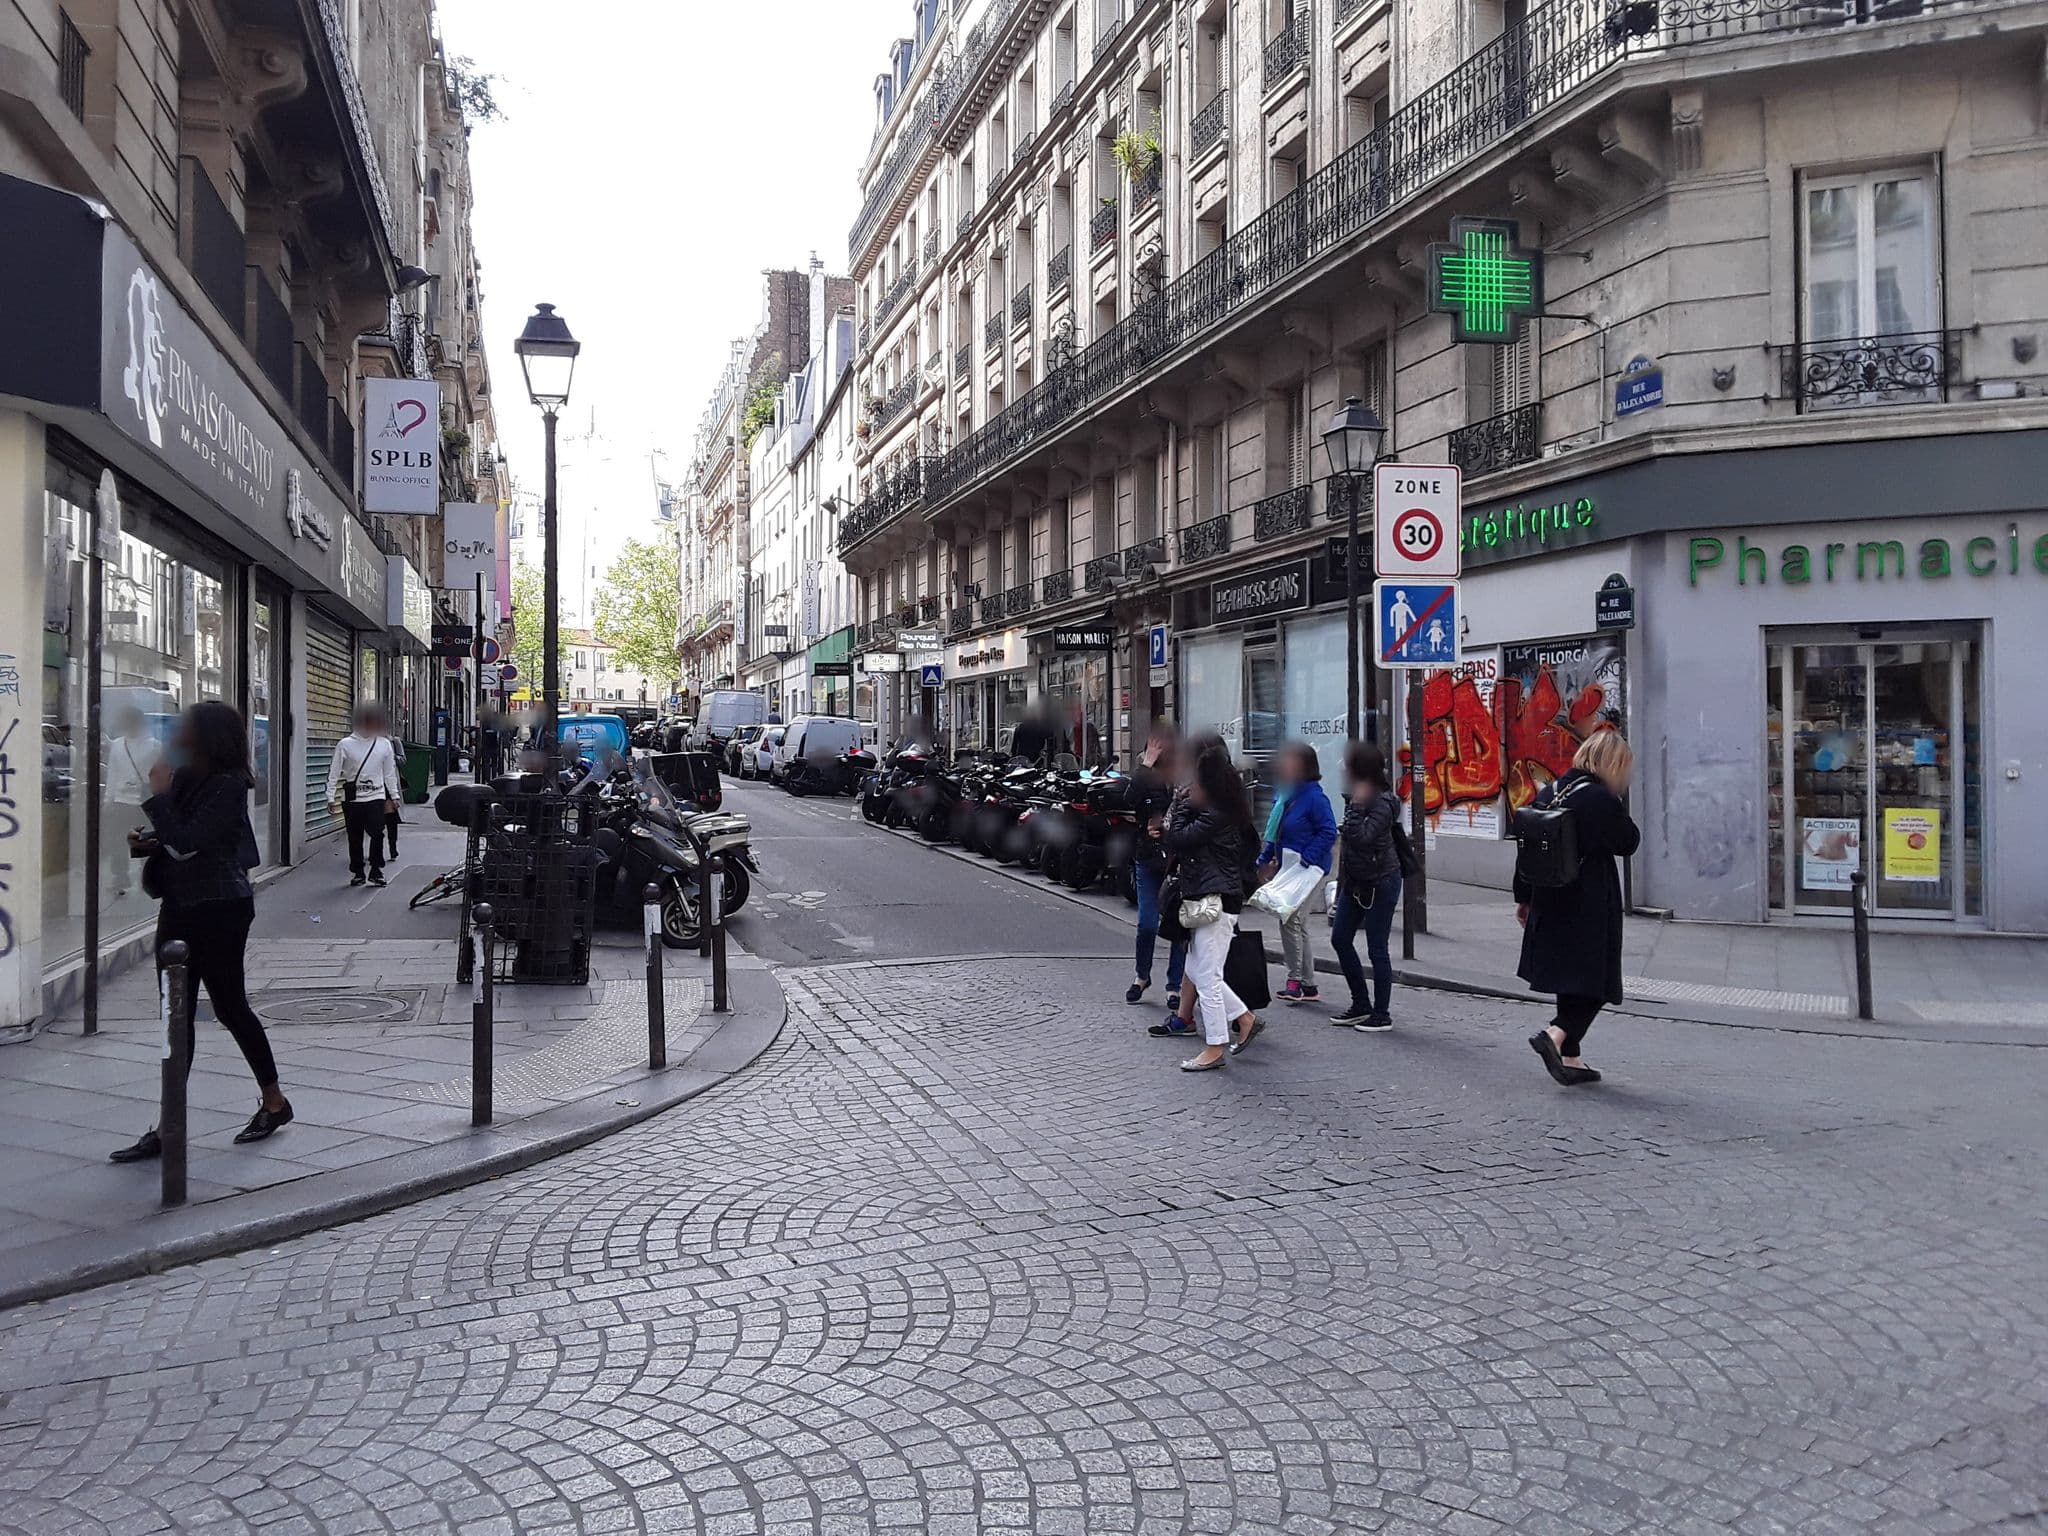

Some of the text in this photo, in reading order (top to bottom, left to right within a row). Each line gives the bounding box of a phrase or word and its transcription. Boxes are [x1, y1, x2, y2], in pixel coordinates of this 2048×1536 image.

[1632, 382, 1646, 394] RUE
[1617, 389, 1662, 412] D'ALEXANDRIE
[168, 346, 274, 492] RINASCIMENTO
[181, 424, 265, 508] MADE IN ITALY
[370, 449, 433, 468] SPLB
[370, 474, 431, 485] BUYING OFFICE
[1395, 480, 1441, 494] ZONE
[1404, 524, 1433, 546] 30
[1690, 522, 2048, 587] Pharmacie
[806, 563, 814, 596] KIUT
[1609, 598, 1620, 607] RUE
[1598, 610, 1633, 621] D'ALEXANDRIE
[454, 637, 472, 645] ONE
[899, 633, 937, 642] Pourquoi
[1056, 632, 1110, 645] MAISON MARLEY
[1153, 634, 1161, 660] P
[1539, 649, 1590, 666] FILORGA
[1301, 719, 1345, 735] HEARTLESS JEA
